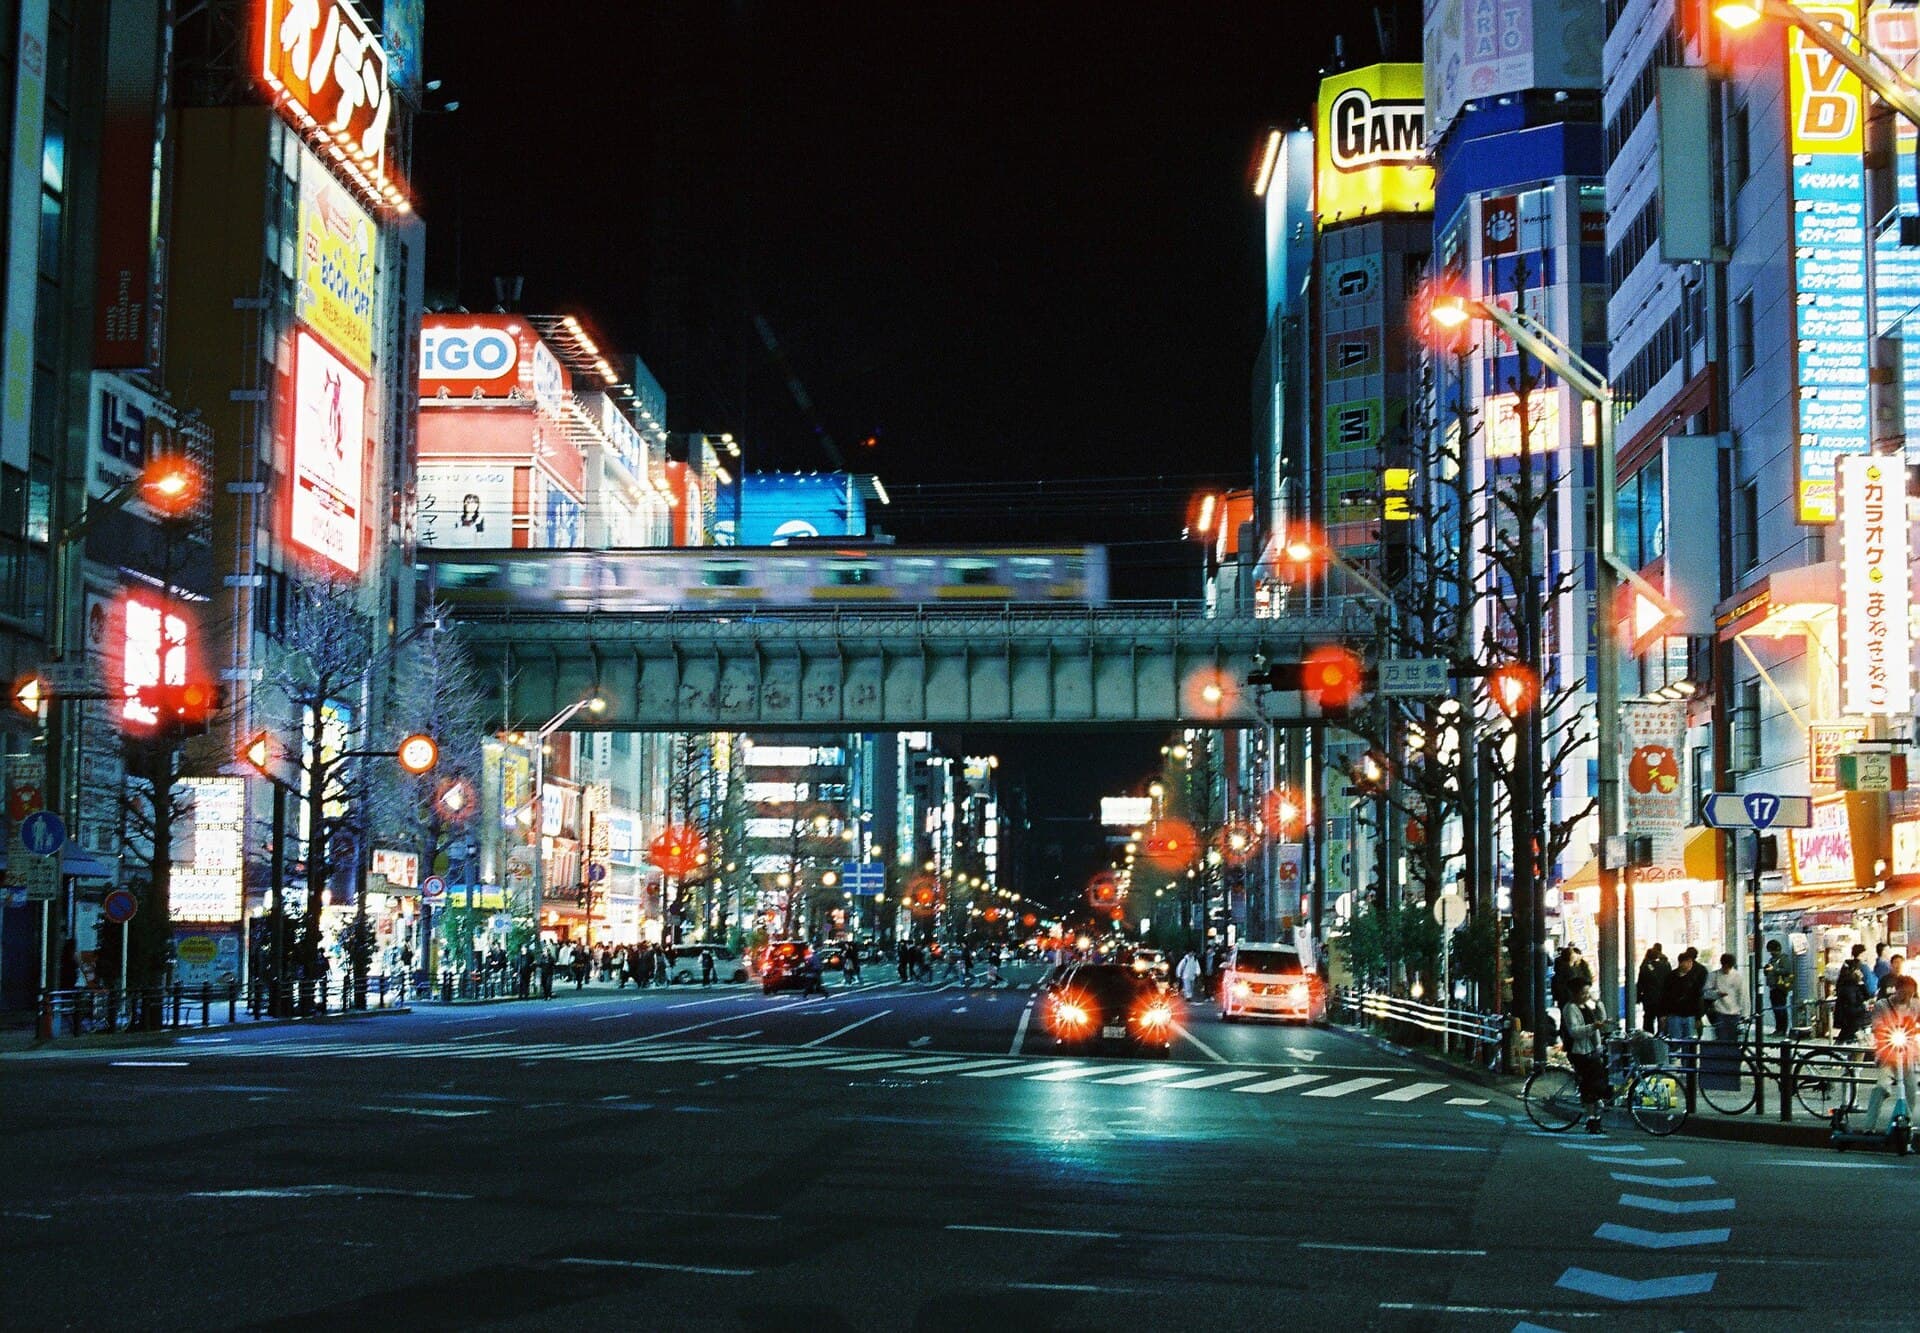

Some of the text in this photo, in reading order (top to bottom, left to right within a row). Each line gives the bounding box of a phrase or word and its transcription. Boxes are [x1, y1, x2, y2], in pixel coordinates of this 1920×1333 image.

[1864, 483, 1888, 706] カラオケ まねきねこ
[1749, 797, 1775, 820] 17
